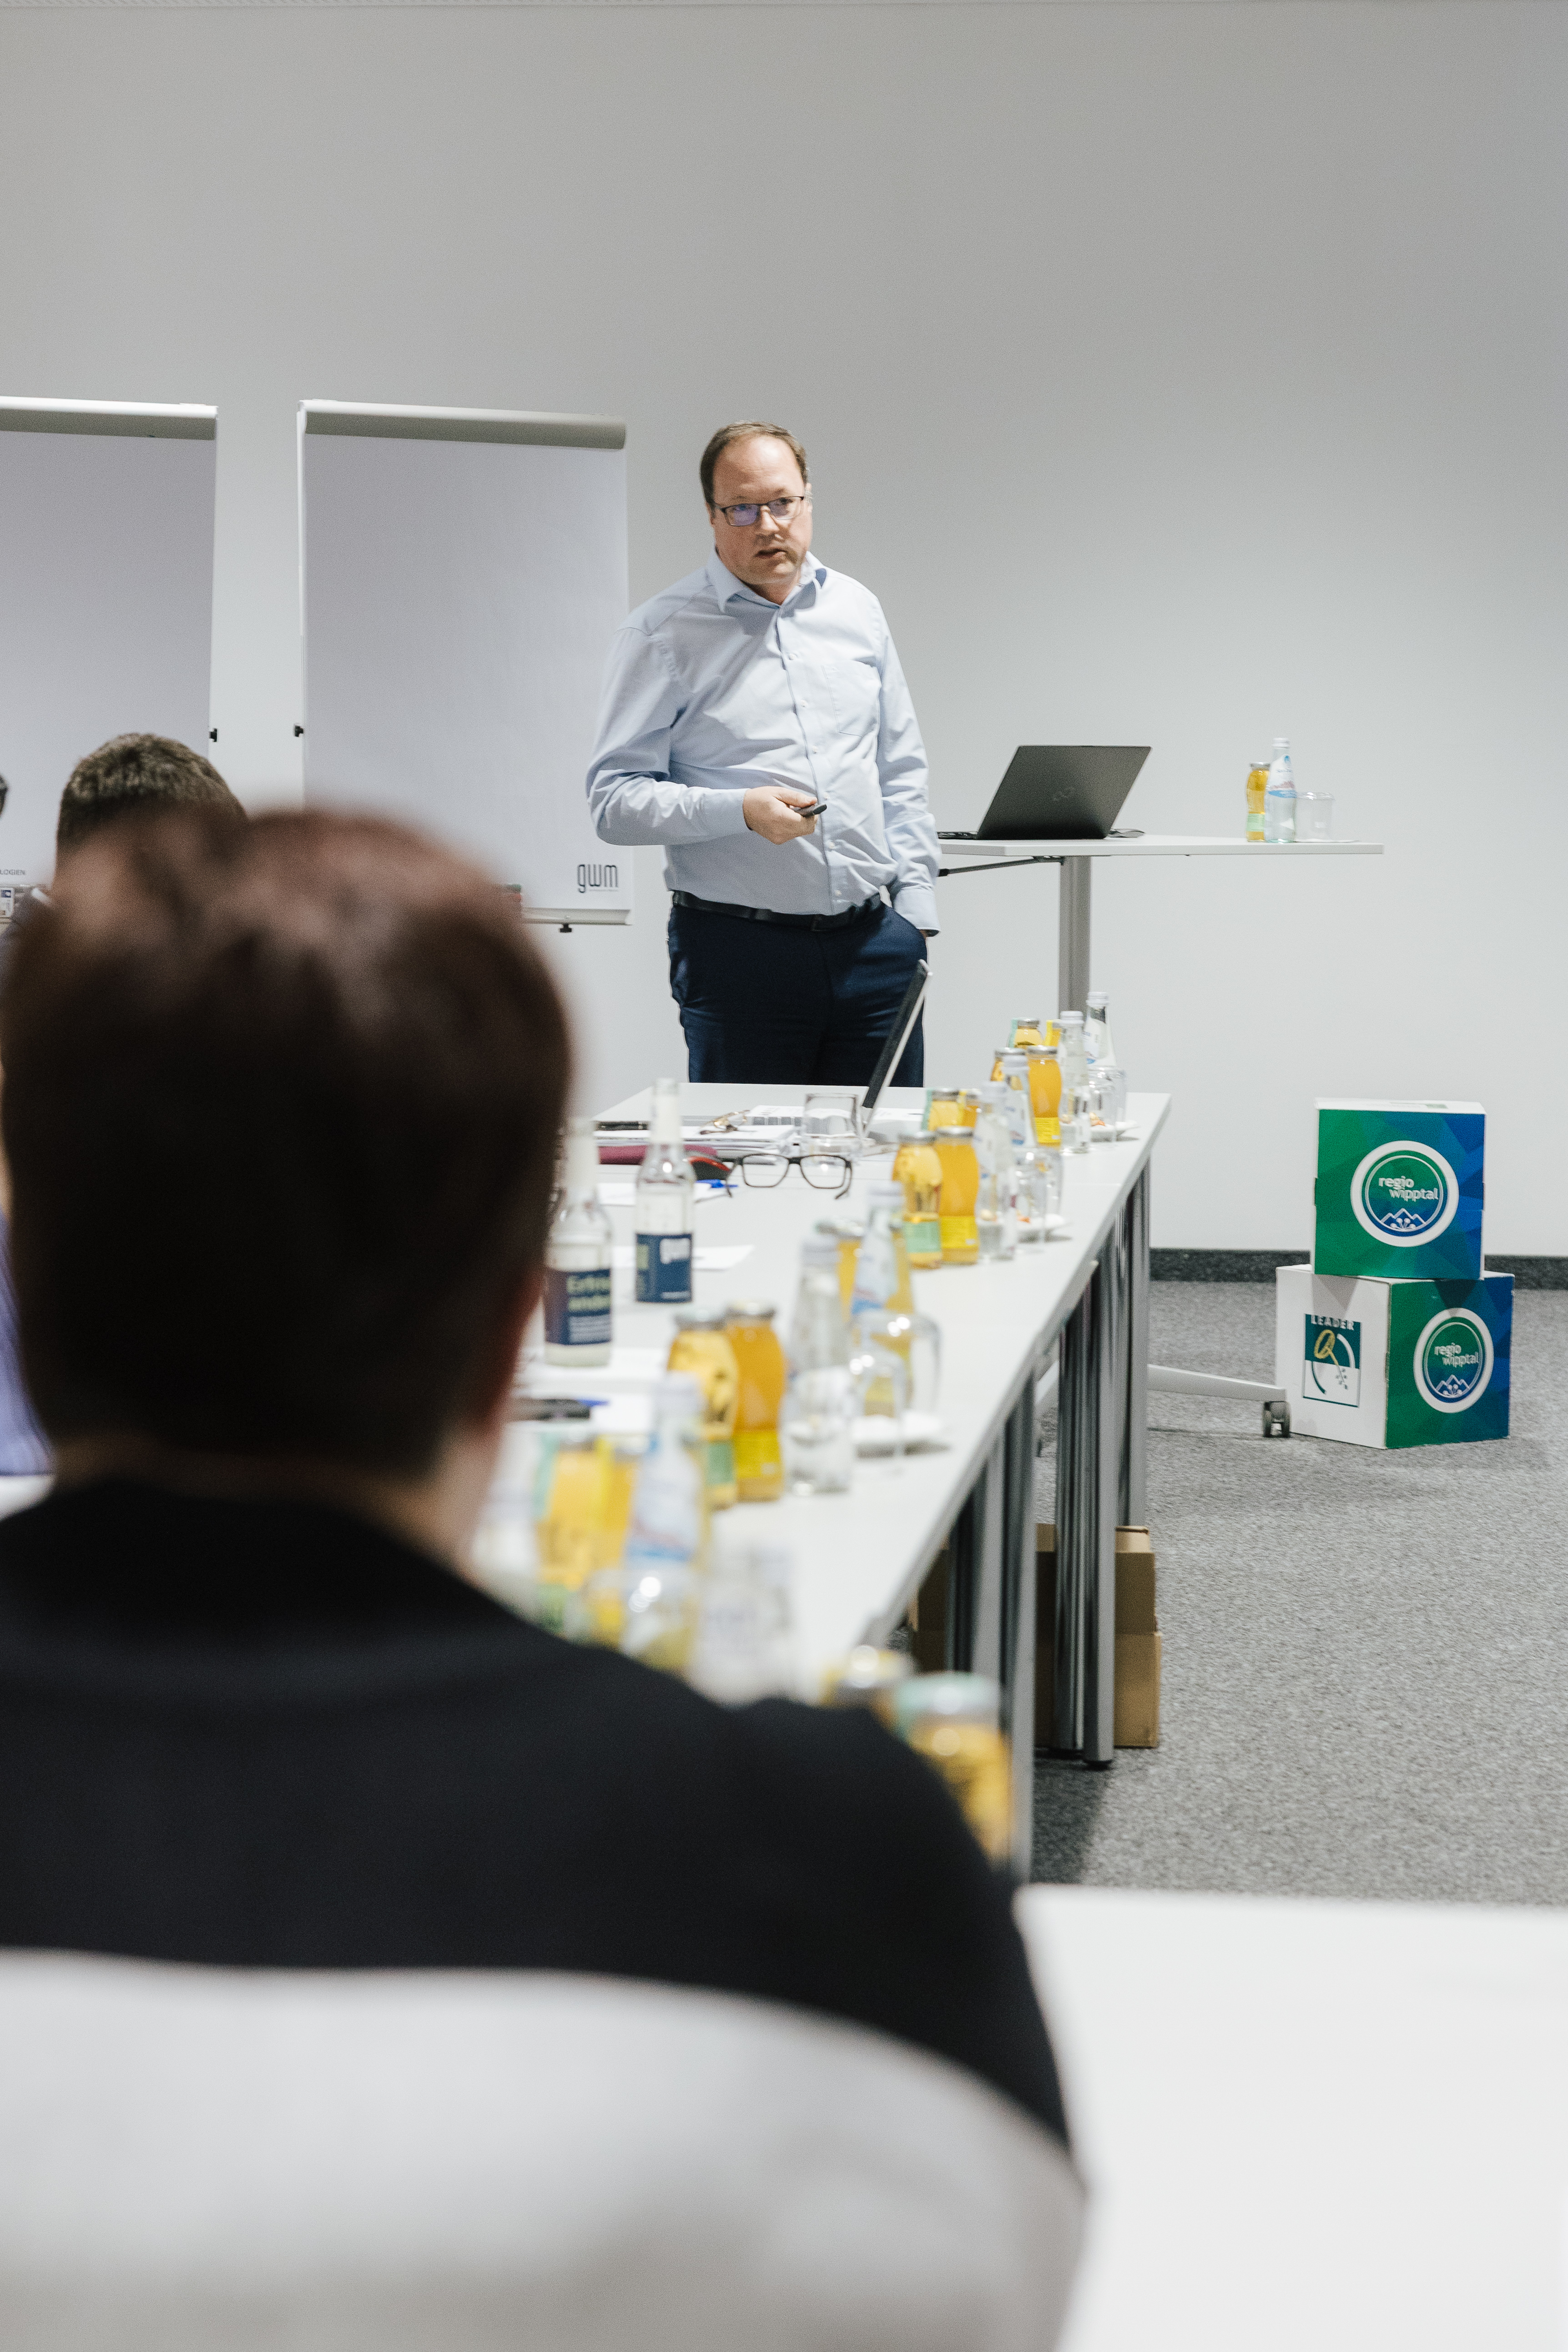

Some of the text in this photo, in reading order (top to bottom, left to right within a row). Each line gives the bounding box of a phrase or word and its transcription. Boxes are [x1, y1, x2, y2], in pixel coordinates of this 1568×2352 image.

[577, 864, 618, 893] gwm
[1378, 1176, 1415, 1190] regio
[1389, 1188, 1439, 1202] wipptal
[1311, 1315, 1354, 1330] LEADER
[1434, 1342, 1462, 1357] regio
[1442, 1352, 1479, 1368] wipptal
